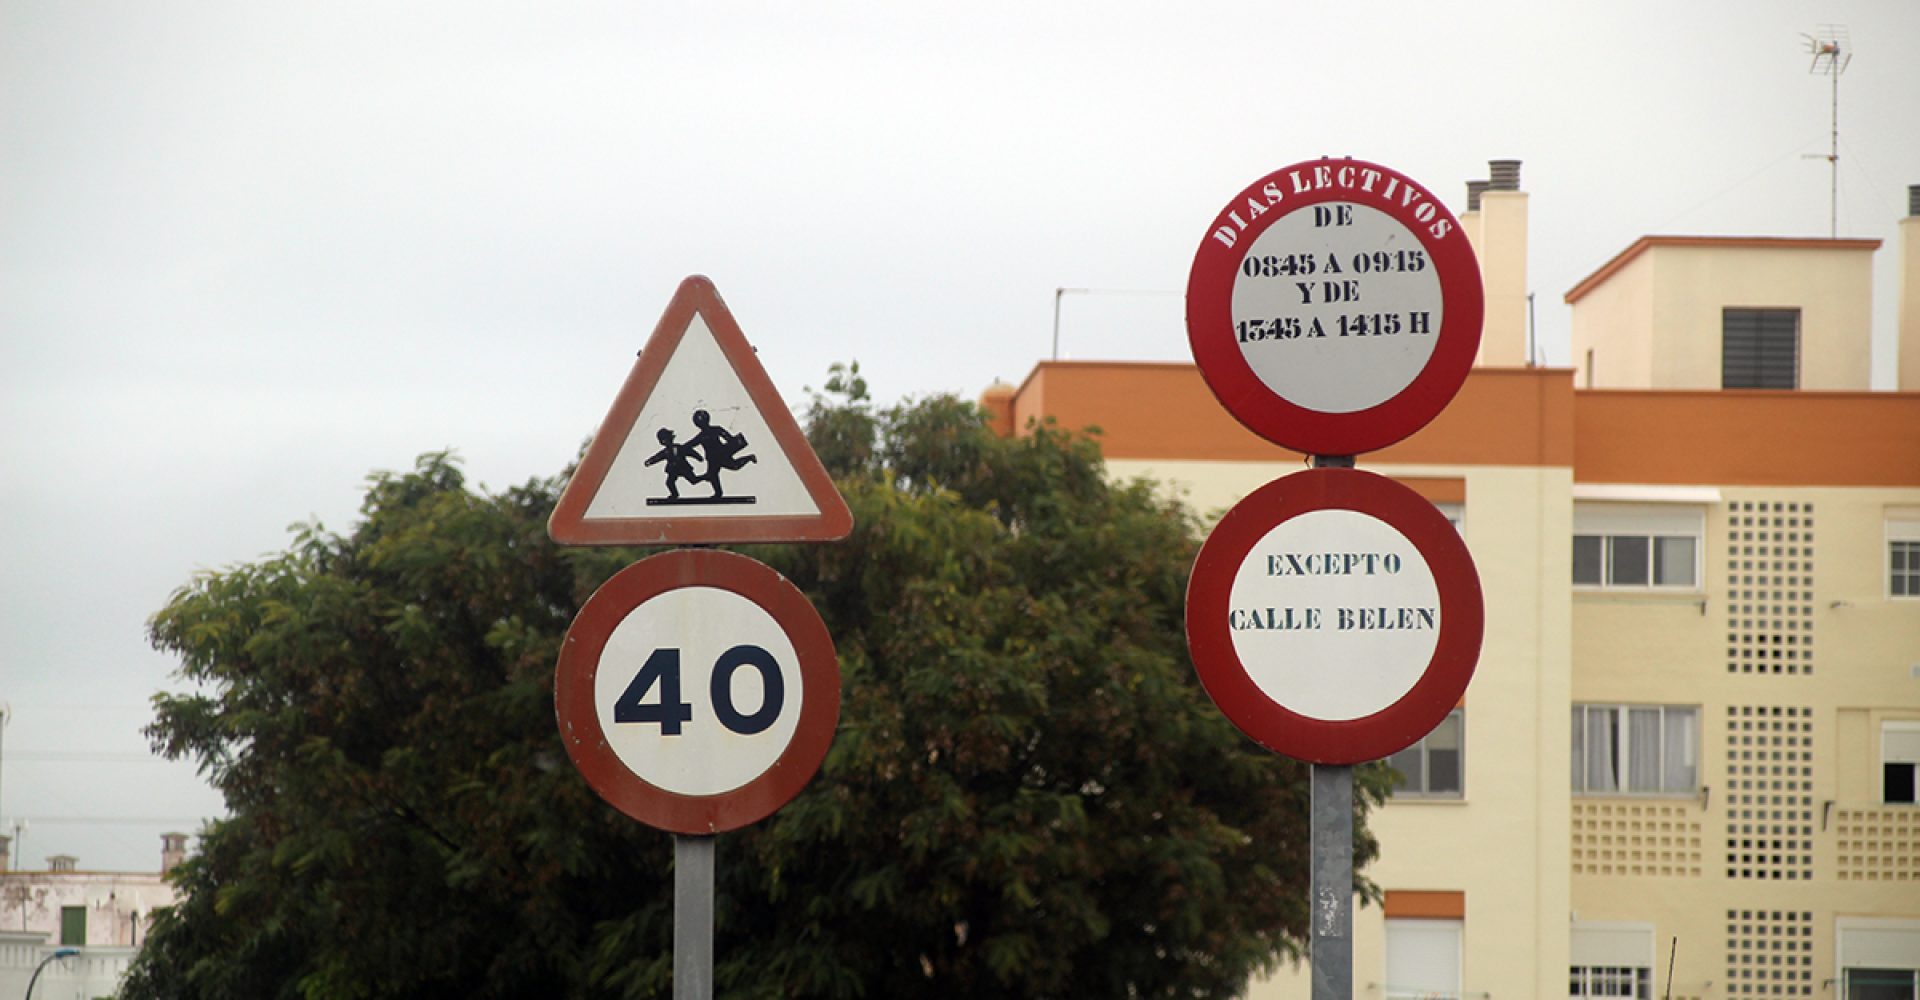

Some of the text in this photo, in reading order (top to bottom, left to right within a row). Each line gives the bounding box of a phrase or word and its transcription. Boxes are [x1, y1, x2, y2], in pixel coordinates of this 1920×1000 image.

[1213, 165, 1453, 249] DIAS LECTIVOS
[1313, 205, 1353, 227] DE
[1323, 253, 1342, 273] A
[1296, 280, 1360, 304] Y DE
[1307, 316, 1326, 338] A
[1409, 312, 1430, 333] H
[1267, 553, 1401, 576] EXCEPTO
[1229, 608, 1435, 630] CALLE BELEN
[614, 644, 785, 736] 40
